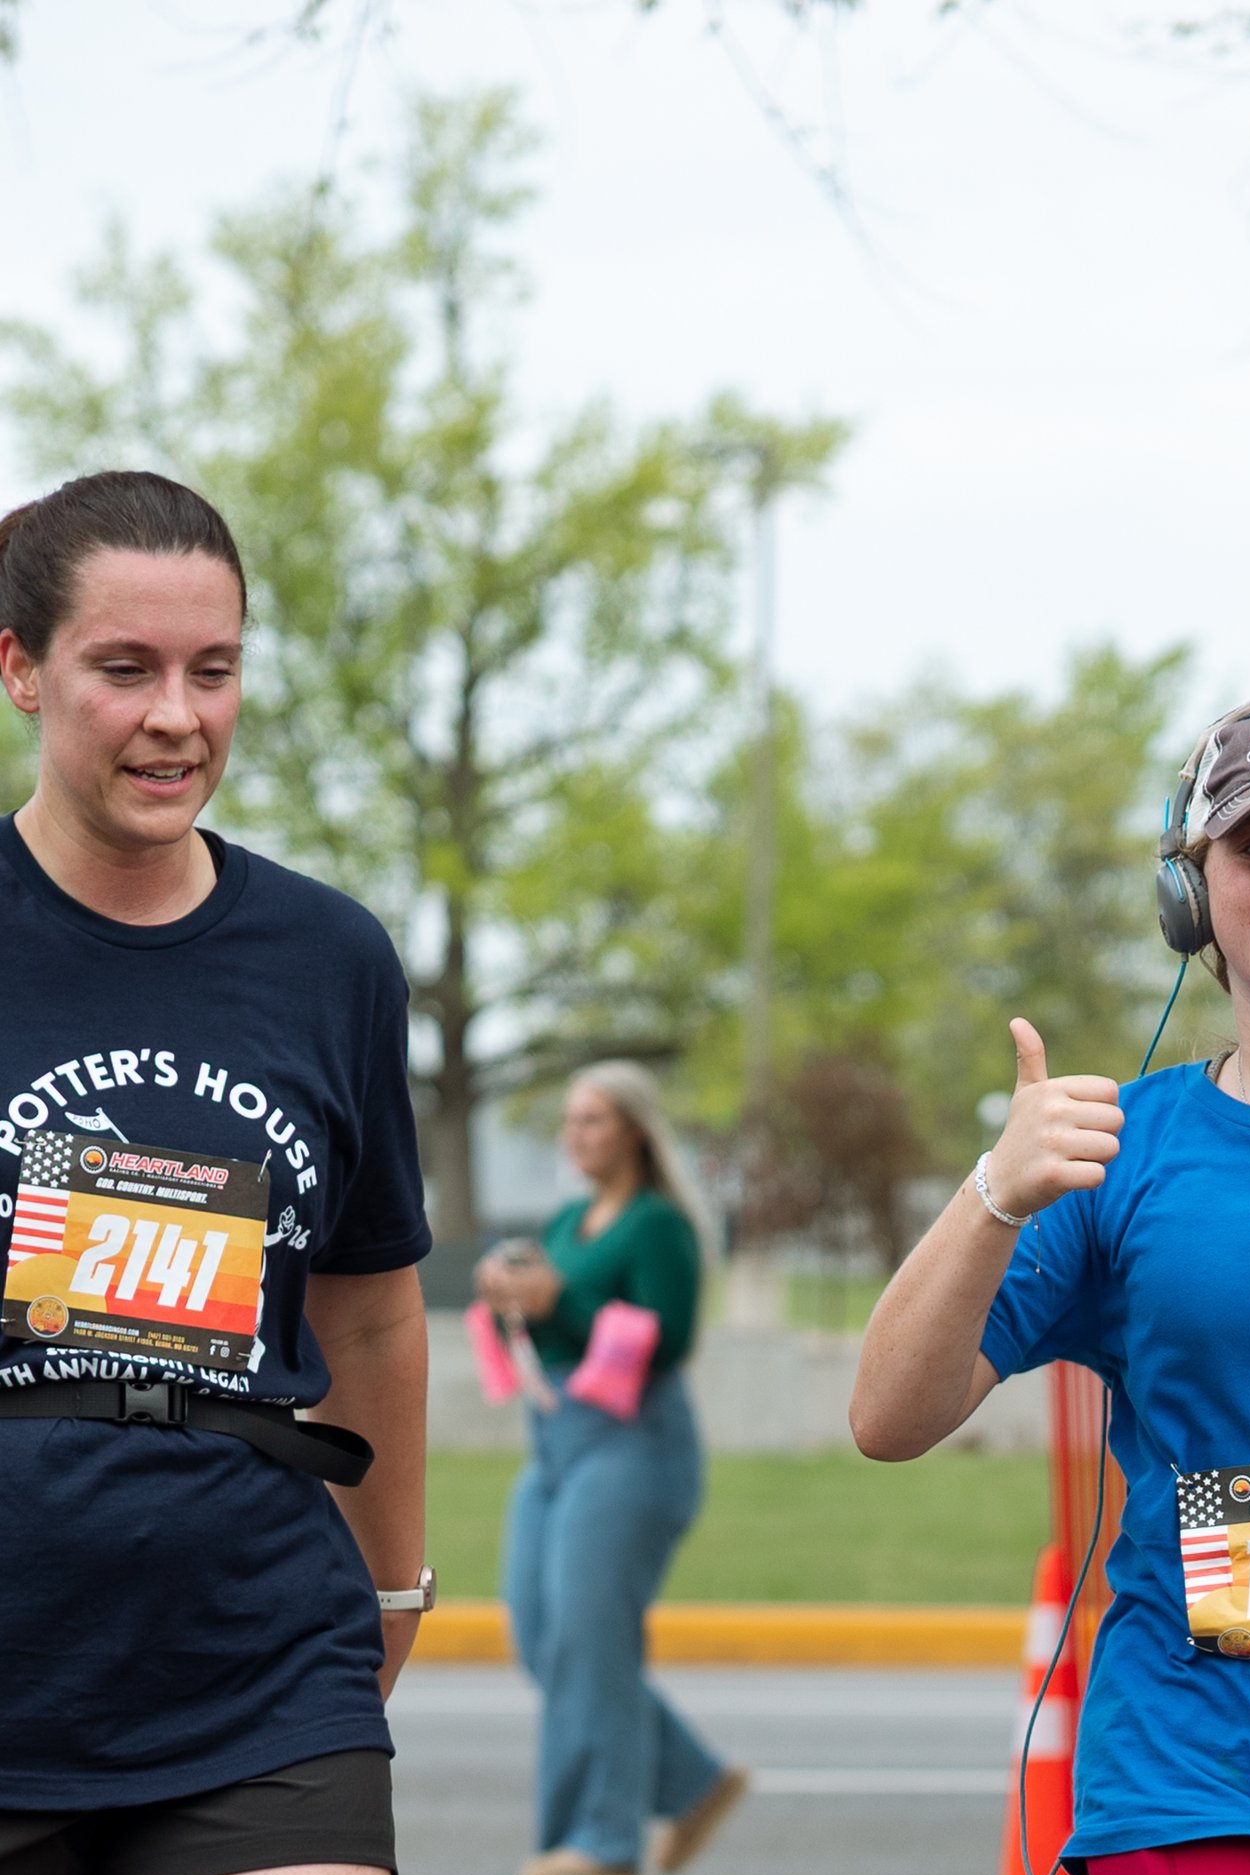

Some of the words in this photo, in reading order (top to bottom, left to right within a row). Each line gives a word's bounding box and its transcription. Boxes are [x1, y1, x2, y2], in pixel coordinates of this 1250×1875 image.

[0, 1048, 179, 1157] POTTER'S
[194, 1062, 317, 1195] HOUSE
[109, 1151, 230, 1184] HEARTLAND
[95, 1177, 115, 1190] GOD.
[116, 1180, 155, 1196] COUNTRY.
[156, 1186, 208, 1204] MULTISPORT.
[287, 1224, 311, 1250] 26
[68, 1213, 229, 1312] 2141
